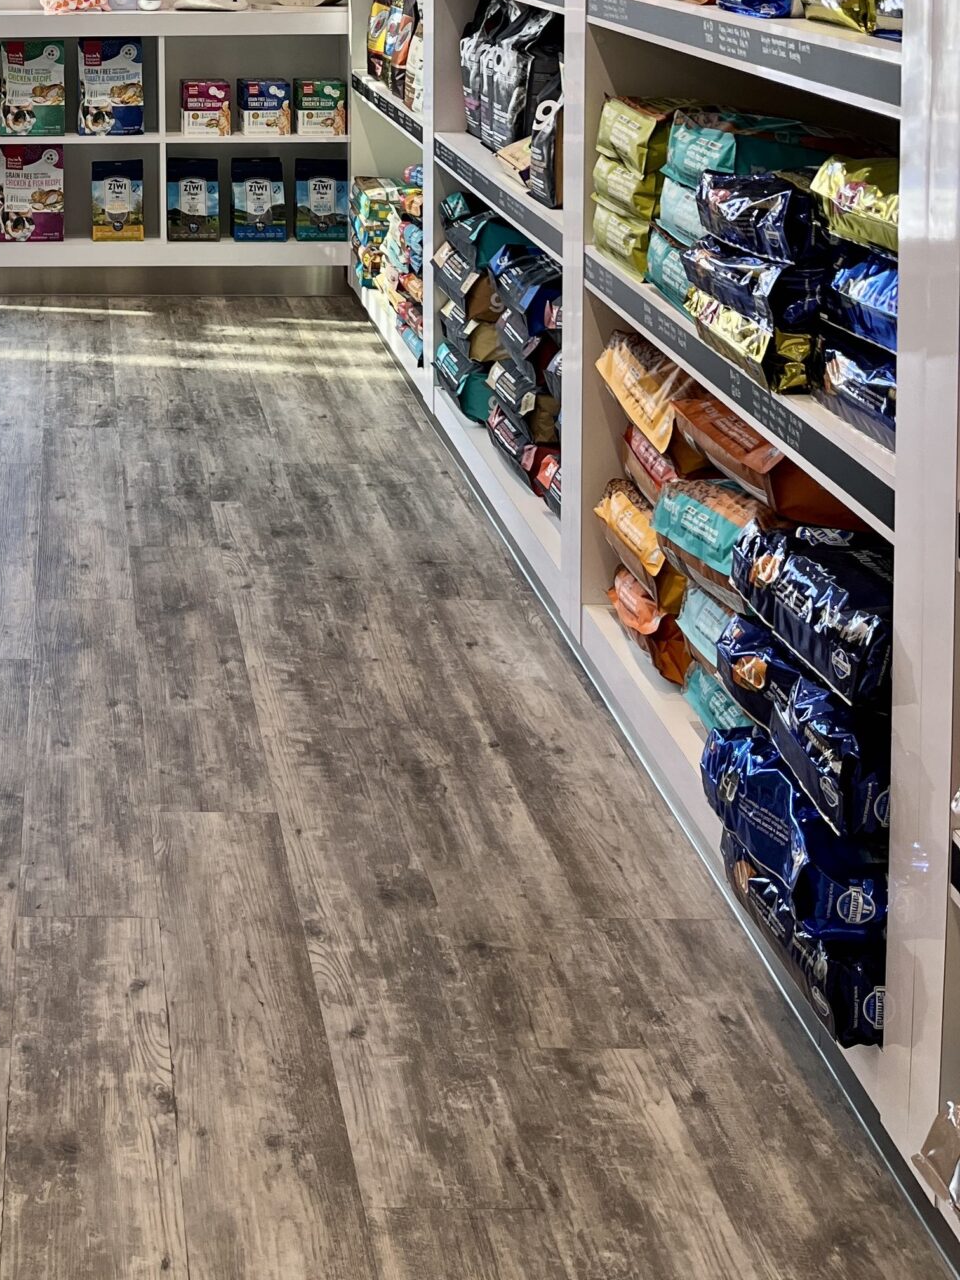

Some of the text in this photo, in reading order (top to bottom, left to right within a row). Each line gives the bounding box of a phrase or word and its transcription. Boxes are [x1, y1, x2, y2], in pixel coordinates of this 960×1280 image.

[7, 66, 22, 74] GRAIN
[7, 73, 52, 83] CHICKEN RECIPE
[125, 71, 141, 80] RECIPE
[5, 171, 21, 179] GRAIN
[5, 179, 27, 188] CHICKEN
[44, 178, 62, 187] RECIPE
[312, 183, 332, 191] ZIWI
[183, 184, 203, 192] ZIWI
[248, 184, 268, 192] ZIWI
[850, 889, 862, 923] Farmina
